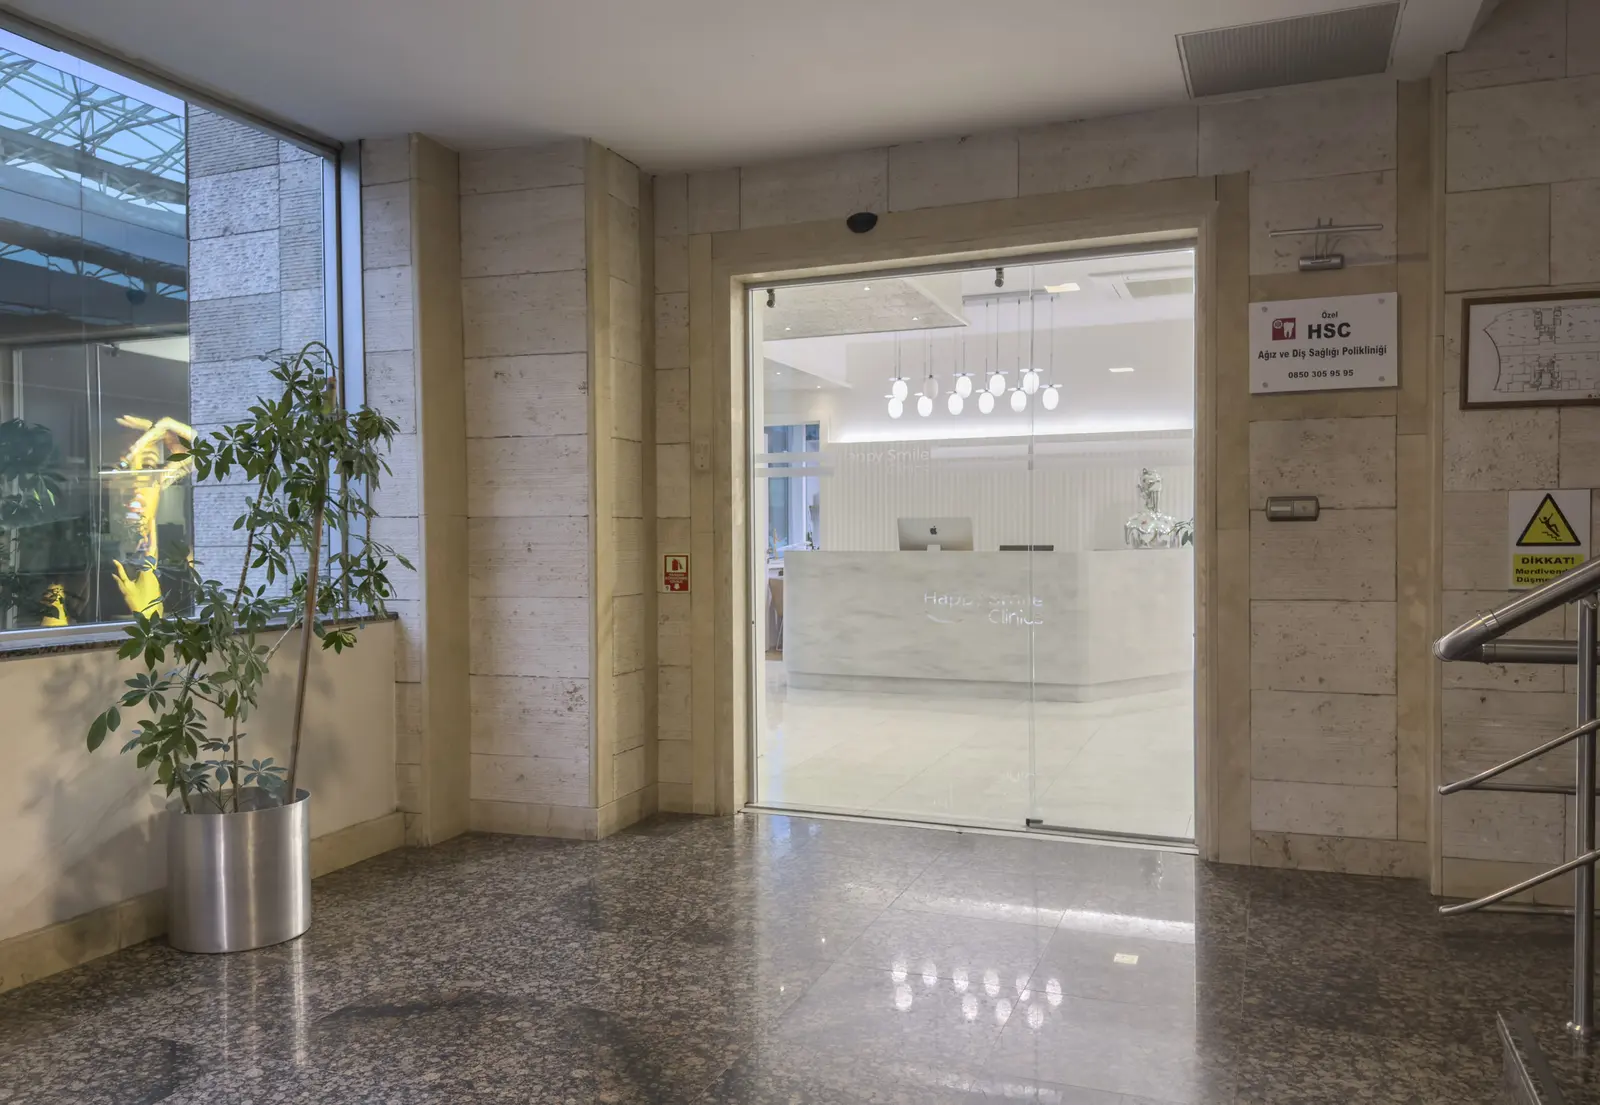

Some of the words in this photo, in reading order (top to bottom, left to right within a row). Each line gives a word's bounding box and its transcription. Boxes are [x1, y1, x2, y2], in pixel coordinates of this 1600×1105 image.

[1321, 310, 1338, 319] Özel
[1307, 322, 1351, 339] HSC
[1257, 350, 1277, 361] Ağız
[1292, 349, 1306, 359] Diş
[1309, 347, 1340, 359] Sağlığı
[1342, 345, 1387, 356] Polikliniği
[1288, 371, 1309, 379] 0850
[1312, 370, 1327, 378] 305
[1343, 369, 1354, 377] 95
[888, 448, 929, 461] Smile
[1521, 556, 1575, 564] DİKKAT!
